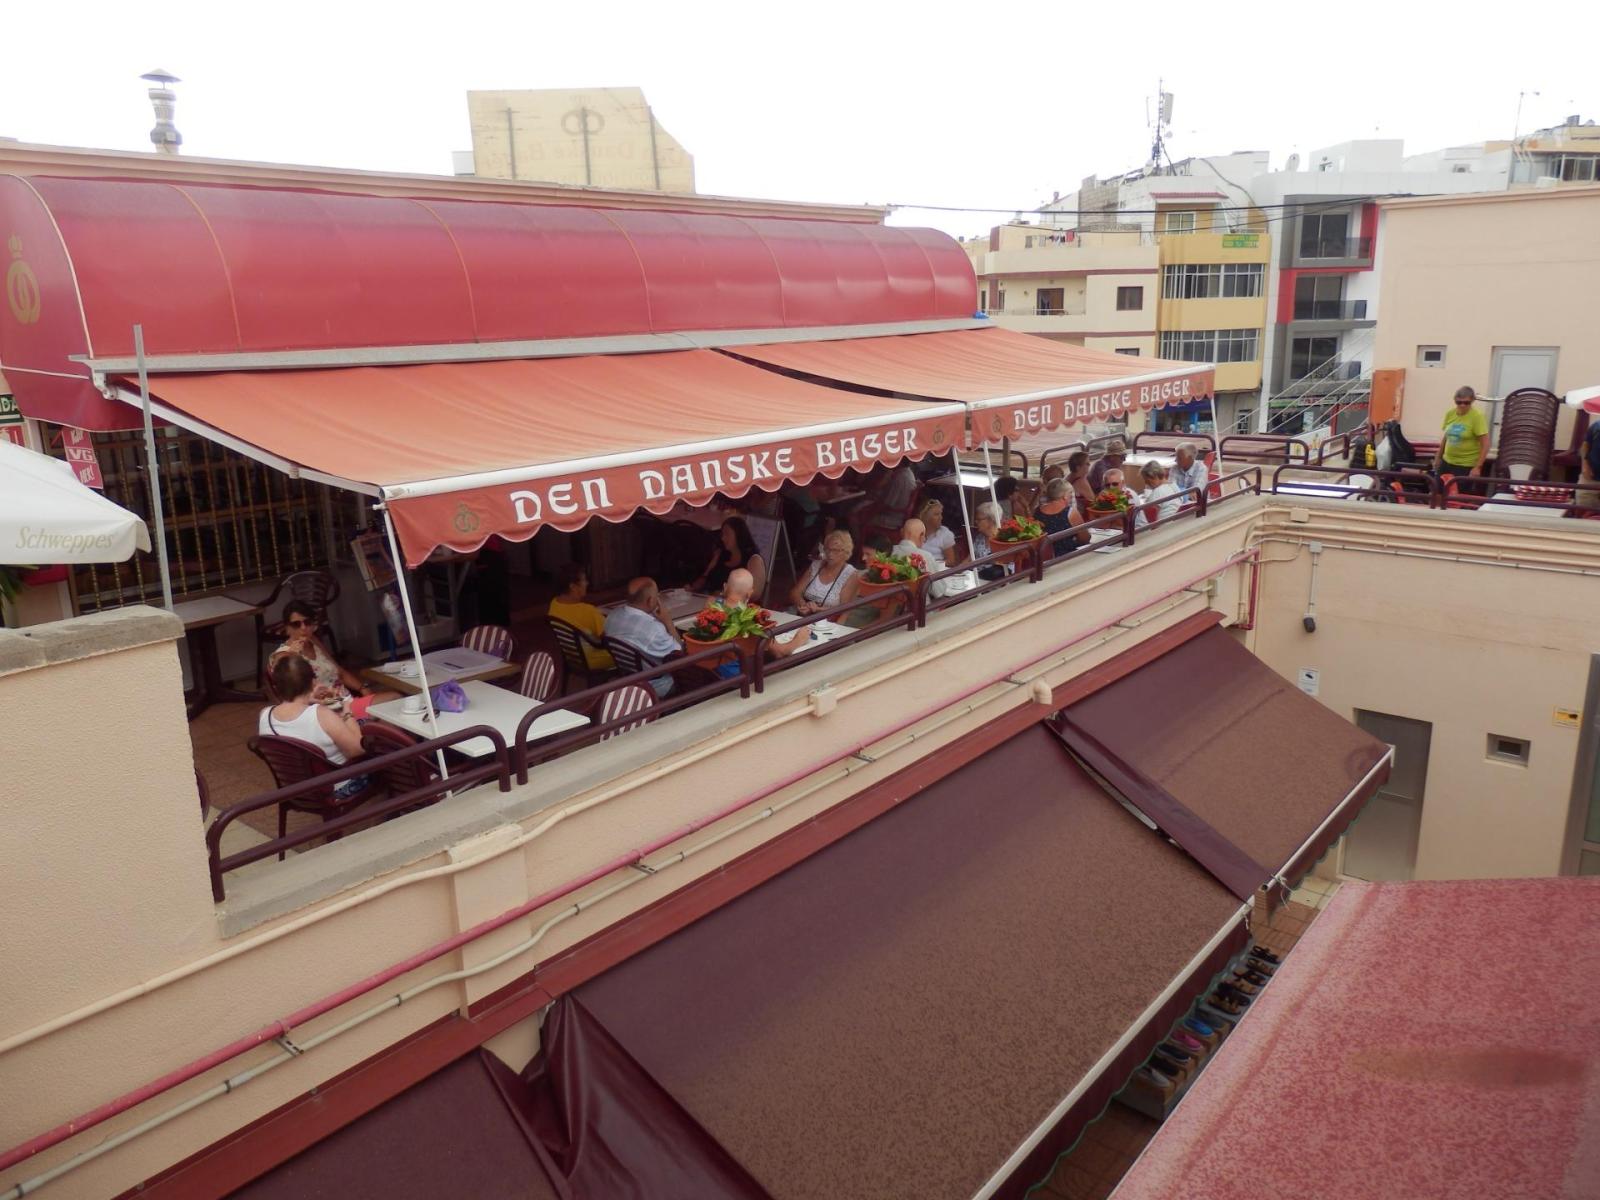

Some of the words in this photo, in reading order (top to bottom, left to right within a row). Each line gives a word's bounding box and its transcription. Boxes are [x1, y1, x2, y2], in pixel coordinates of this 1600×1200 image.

[1014, 404, 1052, 430] DEN
[1064, 389, 1132, 420] DANSKE
[1140, 378, 1190, 402] BAGER
[68, 448, 94, 461] VG
[510, 477, 613, 523] DEN
[639, 447, 796, 499] DANSKE
[816, 428, 919, 468] BAGER
[16, 526, 114, 553] Schweppes
